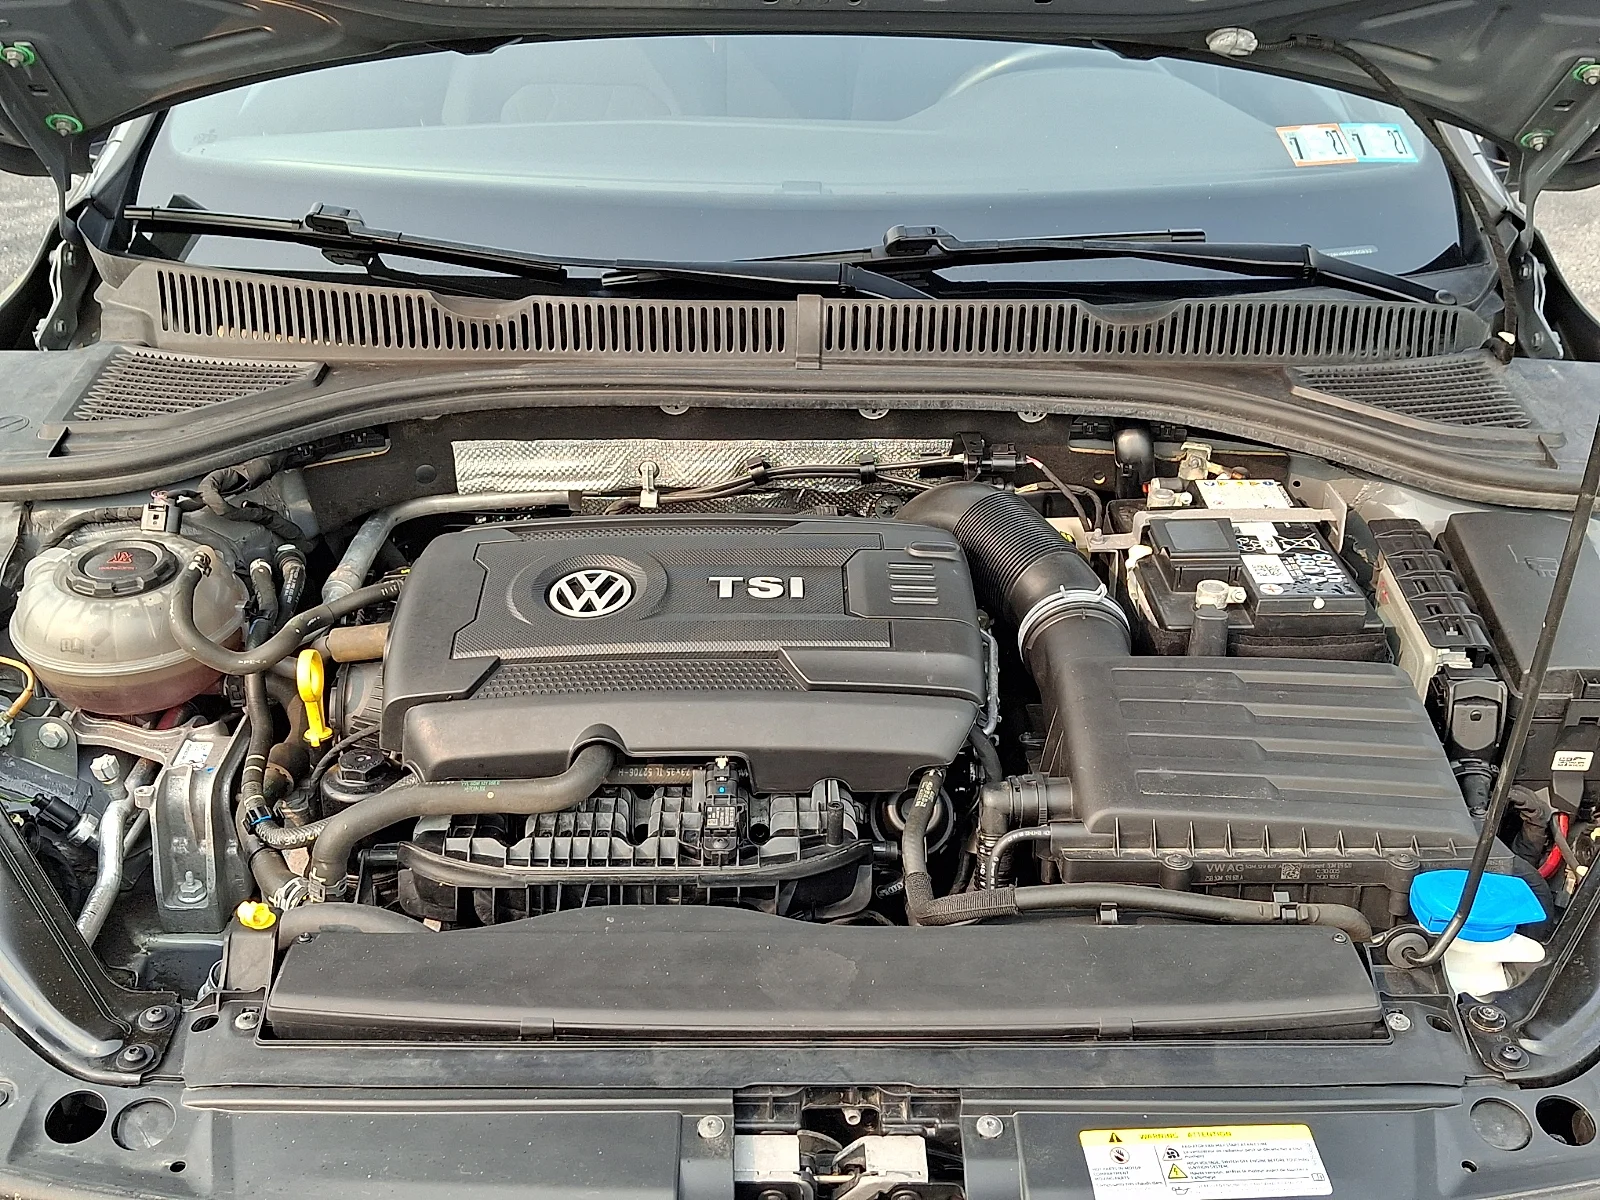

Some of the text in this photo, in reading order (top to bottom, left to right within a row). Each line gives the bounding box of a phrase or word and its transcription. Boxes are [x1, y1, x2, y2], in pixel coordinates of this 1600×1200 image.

[708, 577, 806, 599] TSI
[1206, 863, 1244, 872] VW AG
